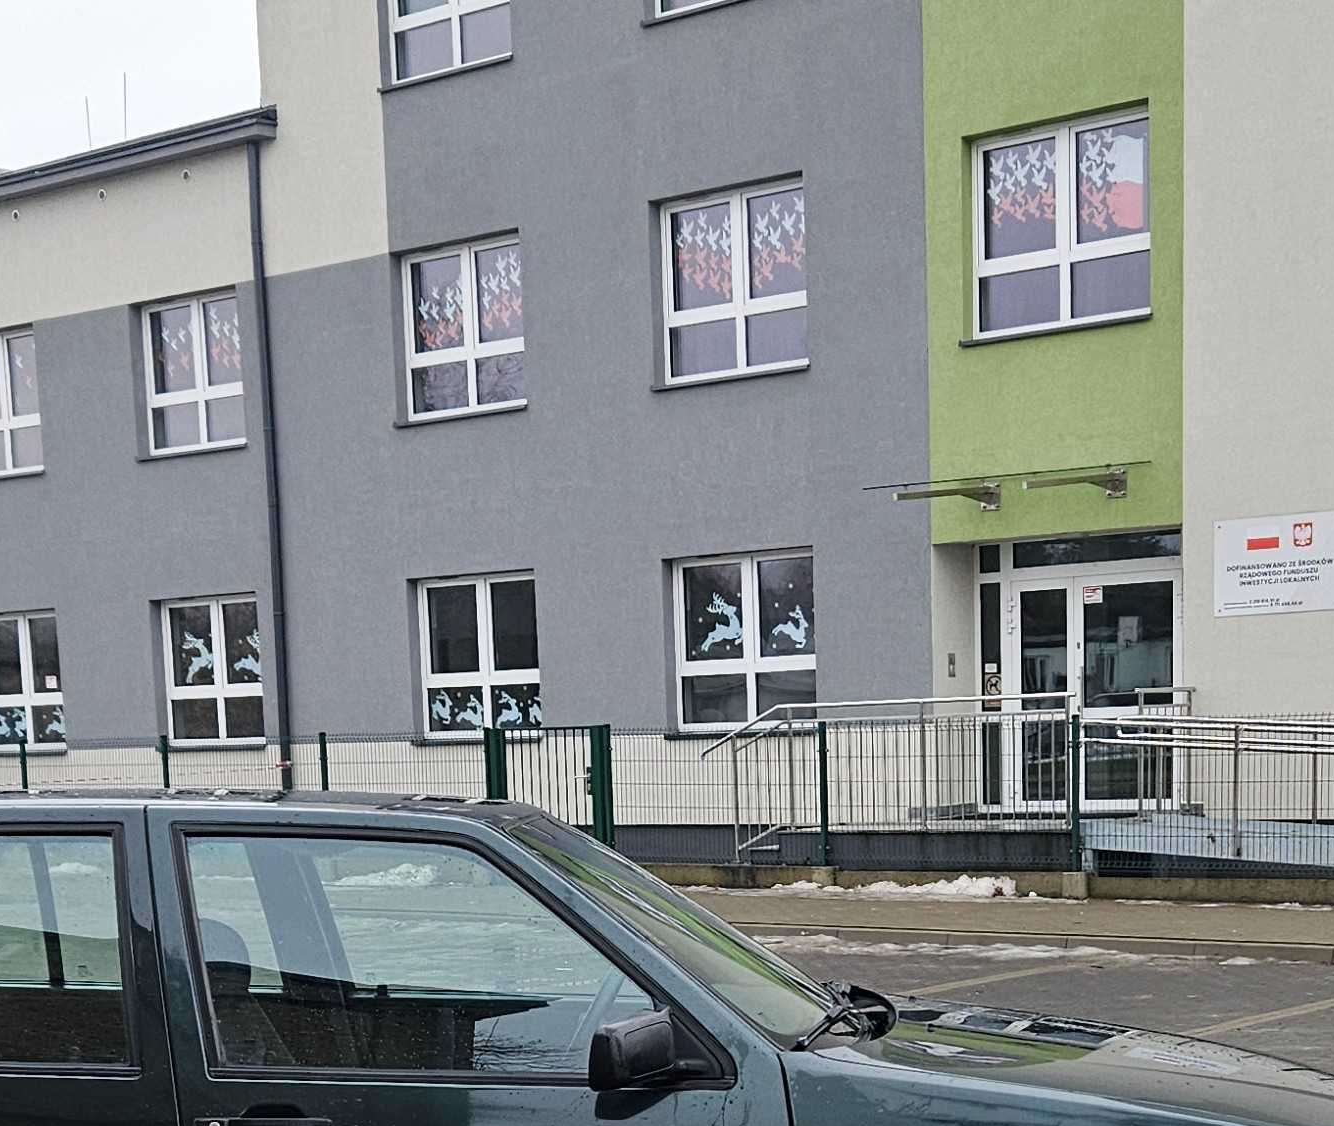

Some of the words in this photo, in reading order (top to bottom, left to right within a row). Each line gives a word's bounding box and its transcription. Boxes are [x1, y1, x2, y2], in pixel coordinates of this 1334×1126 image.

[1227, 562, 1287, 572] DOFINANSOWANO
[1298, 558, 1333, 566] ŚRODKÓW
[1239, 570, 1282, 579] RZĄDOWEGO
[1283, 567, 1318, 576] FUNDUSZU
[1239, 578, 1279, 586] INWESTYCJI
[1280, 575, 1319, 584] LOKALNYCH
